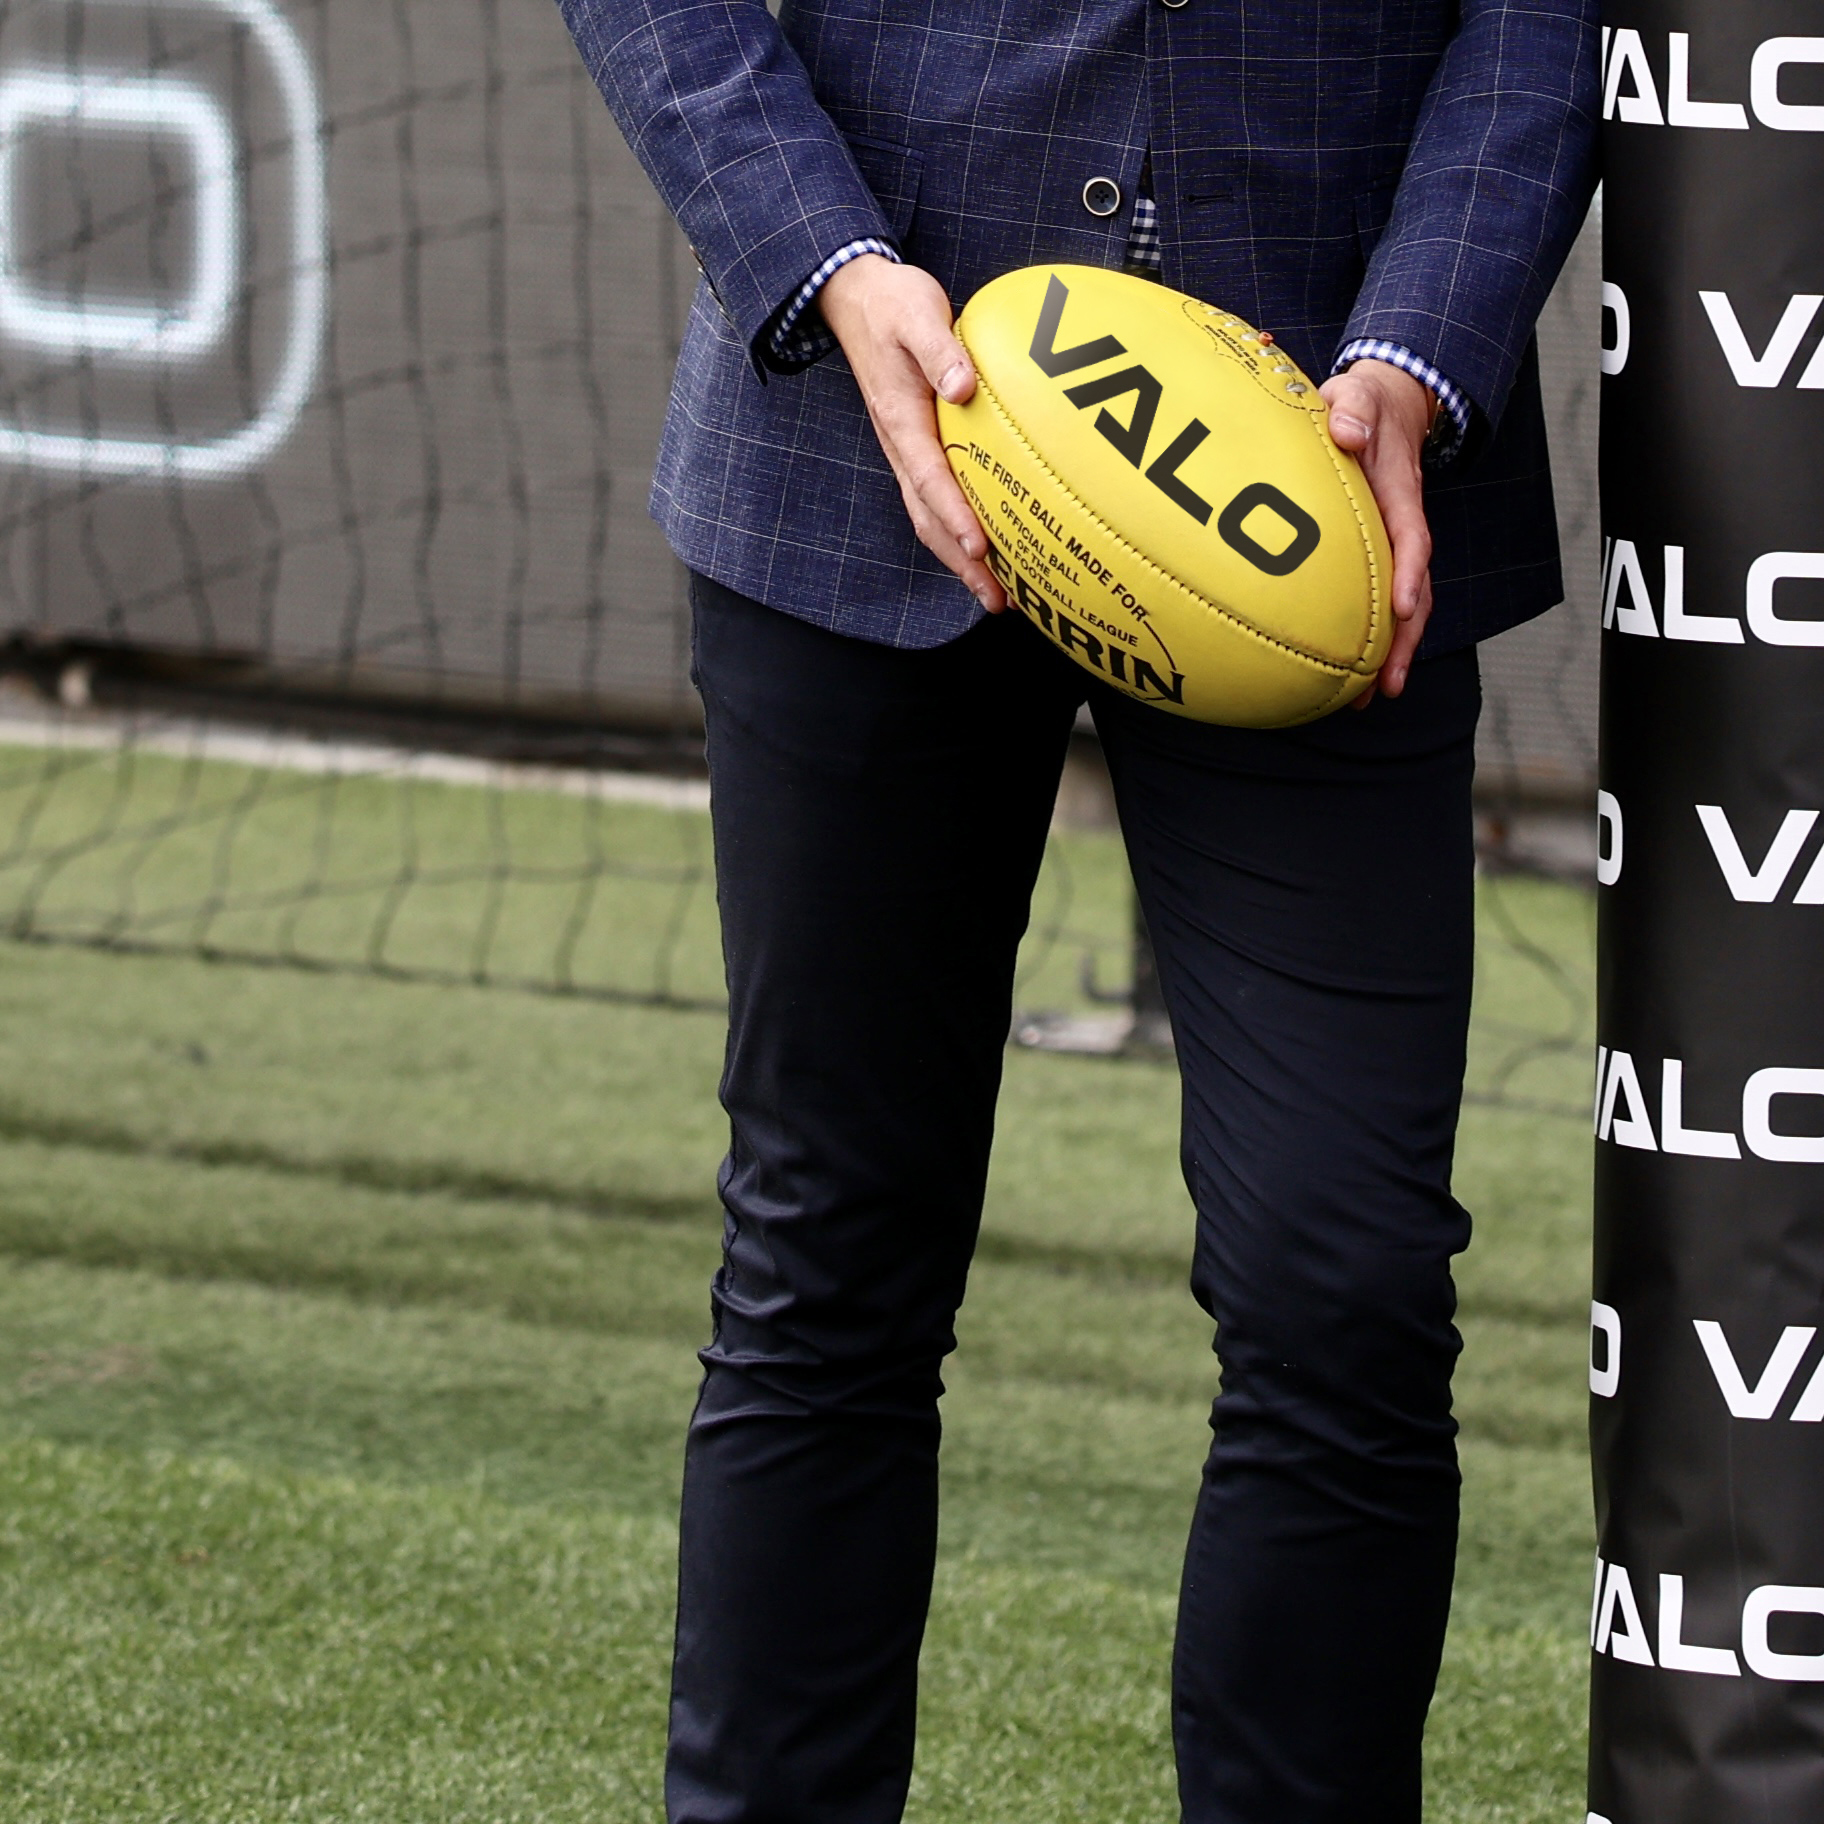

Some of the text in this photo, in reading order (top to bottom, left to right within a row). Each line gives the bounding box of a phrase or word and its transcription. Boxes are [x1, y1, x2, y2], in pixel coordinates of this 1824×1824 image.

[1028, 272, 1322, 577] VALO
[958, 470, 1139, 647] AUSTRALIAN FOOTBALL LEAGUE
[969, 441, 1149, 622] THE FIRST BALL MADE FOR
[1000, 499, 1080, 587] OFFICIAL BALL
[1016, 538, 1052, 577] OF THE
[987, 547, 1186, 706] ERRIN
